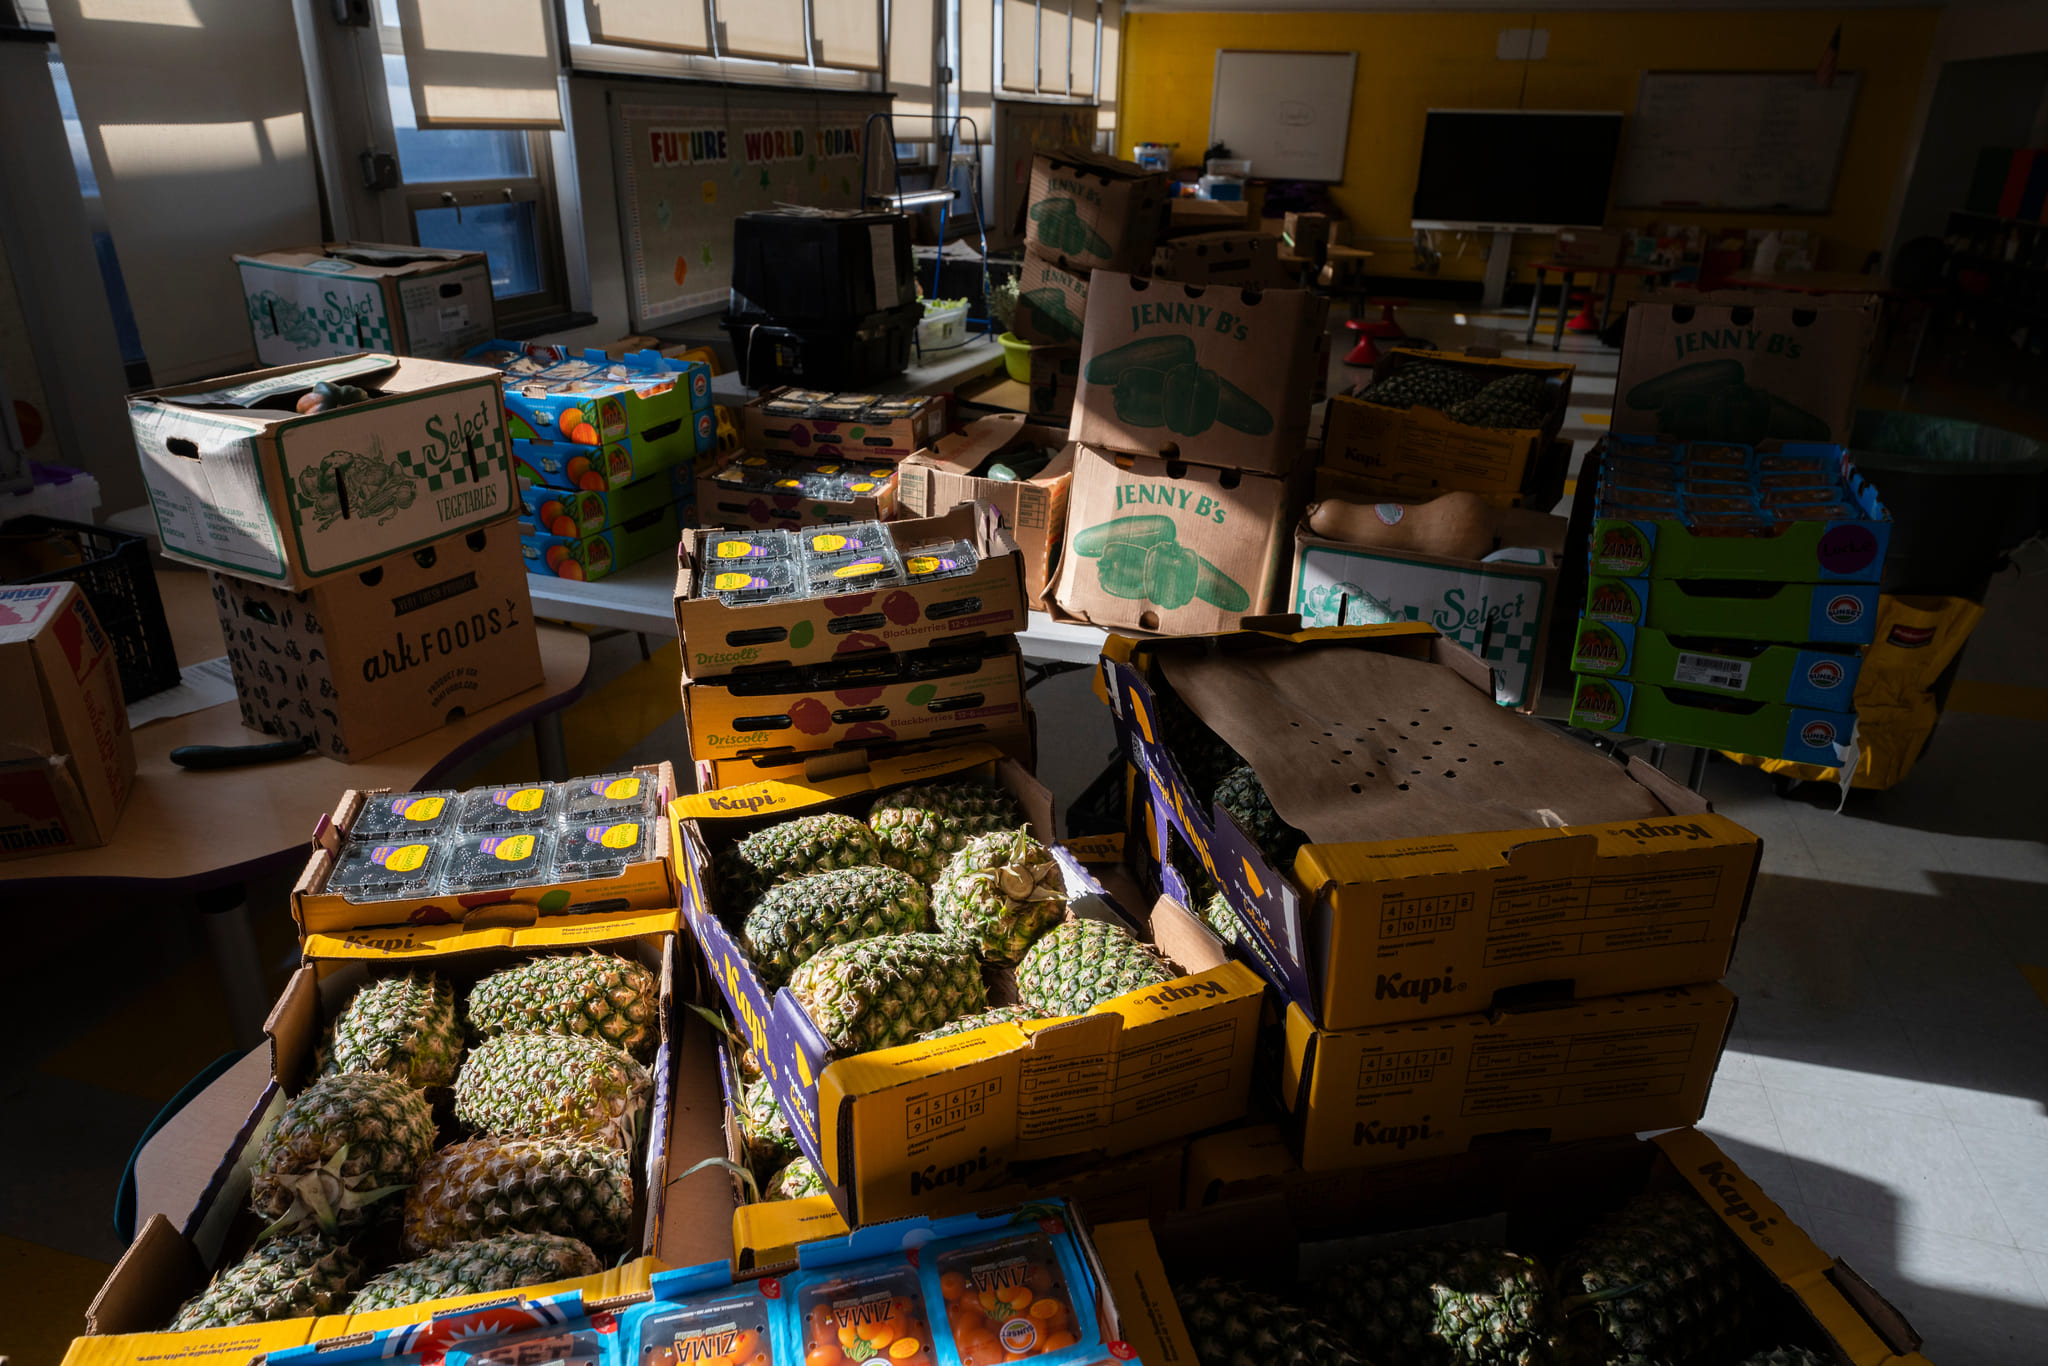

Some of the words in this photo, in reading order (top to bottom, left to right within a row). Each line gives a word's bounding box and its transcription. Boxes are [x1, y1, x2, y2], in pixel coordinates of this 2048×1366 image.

[650, 130, 728, 163] FUTURE
[744, 129, 805, 161] WORLD
[816, 127, 861, 156] TODAY
[1048, 178, 1085, 196] JENNY
[1041, 269, 1075, 289] JENNY
[322, 290, 374, 327] Select
[1131, 301, 1213, 333] JENNY
[1215, 310, 1249, 341] B's
[1675, 328, 1762, 361] JENNY
[1766, 332, 1804, 360] B's
[421, 400, 491, 466] Select
[1345, 446, 1382, 468] Kapi
[436, 484, 497, 522] VEGETABLES
[1115, 483, 1193, 511] JENNY
[1193, 494, 1227, 524] B's
[1600, 541, 1645, 561] ZIMA
[1433, 587, 1525, 631] Select
[1592, 598, 1634, 615] ZIMA
[1828, 606, 1864, 618] SUNSET
[74, 599, 105, 648] IDAHO
[883, 623, 947, 639] Blackberries
[362, 632, 420, 682] ark
[421, 608, 502, 662] FOODS
[696, 647, 760, 665] Driscoll's
[1577, 643, 1620, 663] ZIMA
[1808, 671, 1842, 684] SUNSET
[1577, 693, 1618, 715] ZIMA
[890, 712, 953, 727] Blackberries
[706, 731, 769, 746] Driscoll's
[1801, 730, 1836, 743] SUNSET
[708, 789, 777, 812] Kapi
[2, 828, 67, 850] IDAHO
[1620, 822, 1713, 845] Kapi
[1406, 904, 1414, 914] 5
[1425, 901, 1432, 912] 6
[1442, 899, 1450, 911] 7
[1461, 897, 1468, 907] 8
[1387, 923, 1394, 934] 9
[1402, 920, 1415, 932] 10
[1422, 918, 1432, 929] 11
[1440, 916, 1452, 928] 12
[343, 933, 414, 955] Kapi
[1145, 979, 1228, 1006] Kapi
[1375, 965, 1456, 1003] Kapi
[724, 952, 773, 1066] Kapi
[1380, 1072, 1392, 1083] 10
[1400, 1070, 1410, 1080] 11
[1417, 1068, 1430, 1079] 12
[914, 1106, 921, 1115] 4
[933, 1100, 940, 1110] 5
[952, 1095, 959, 1104] 6
[970, 1088, 977, 1098] 7
[989, 1082, 995, 1092] 8
[914, 1122, 921, 1132] 9
[930, 1115, 942, 1126] 10
[950, 1109, 960, 1120] 11
[968, 1103, 980, 1114] 12
[1353, 1115, 1434, 1150] Kapi
[911, 1146, 988, 1195] Kapi
[1699, 1161, 1766, 1237] Kapi
[972, 1262, 1033, 1293] ZIMA
[834, 1298, 894, 1329] ZIMA
[1001, 1324, 1034, 1338] SUNSET
[163, 1352, 187, 1361] with
[188, 1348, 225, 1358] handle
[225, 1344, 259, 1353] Please
[674, 1329, 738, 1362] ZIMA
